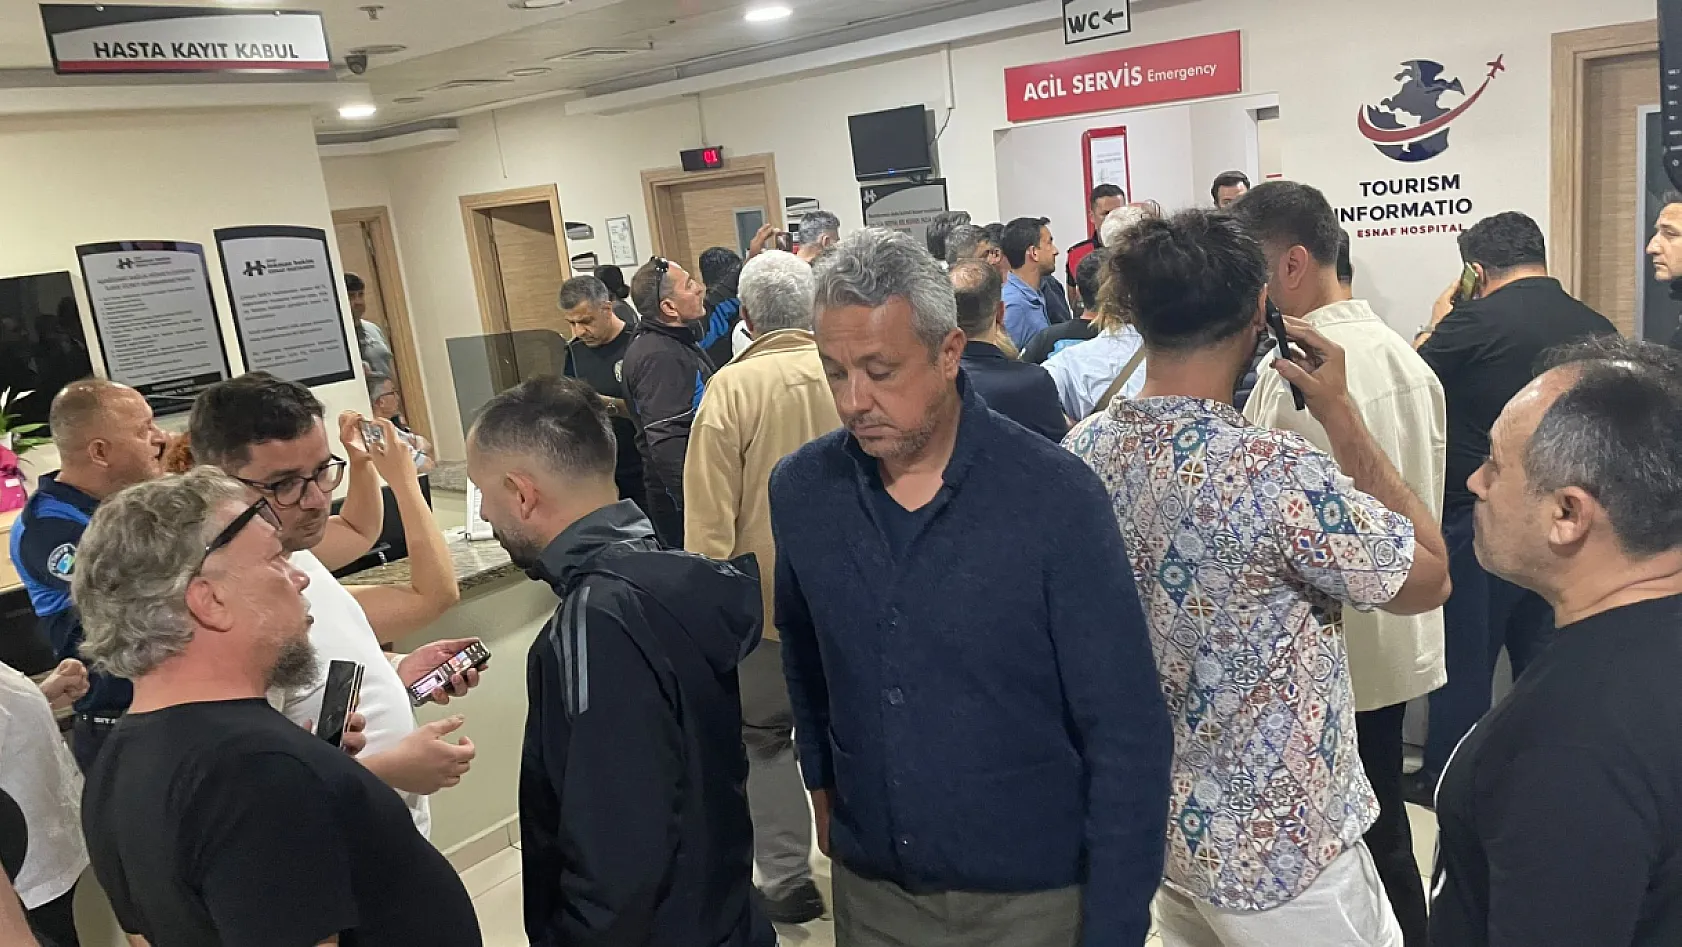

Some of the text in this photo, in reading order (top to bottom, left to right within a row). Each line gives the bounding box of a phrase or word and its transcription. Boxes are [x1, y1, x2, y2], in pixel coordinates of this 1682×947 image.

[1067, 11, 1100, 33] WC
[93, 42, 299, 59] HASTA KAYIT KABUL
[1024, 62, 1218, 101] ACİL SERVİS Emergency
[1359, 173, 1460, 197] TOURISM
[1357, 223, 1464, 238] ESNAF HOSPITAL
